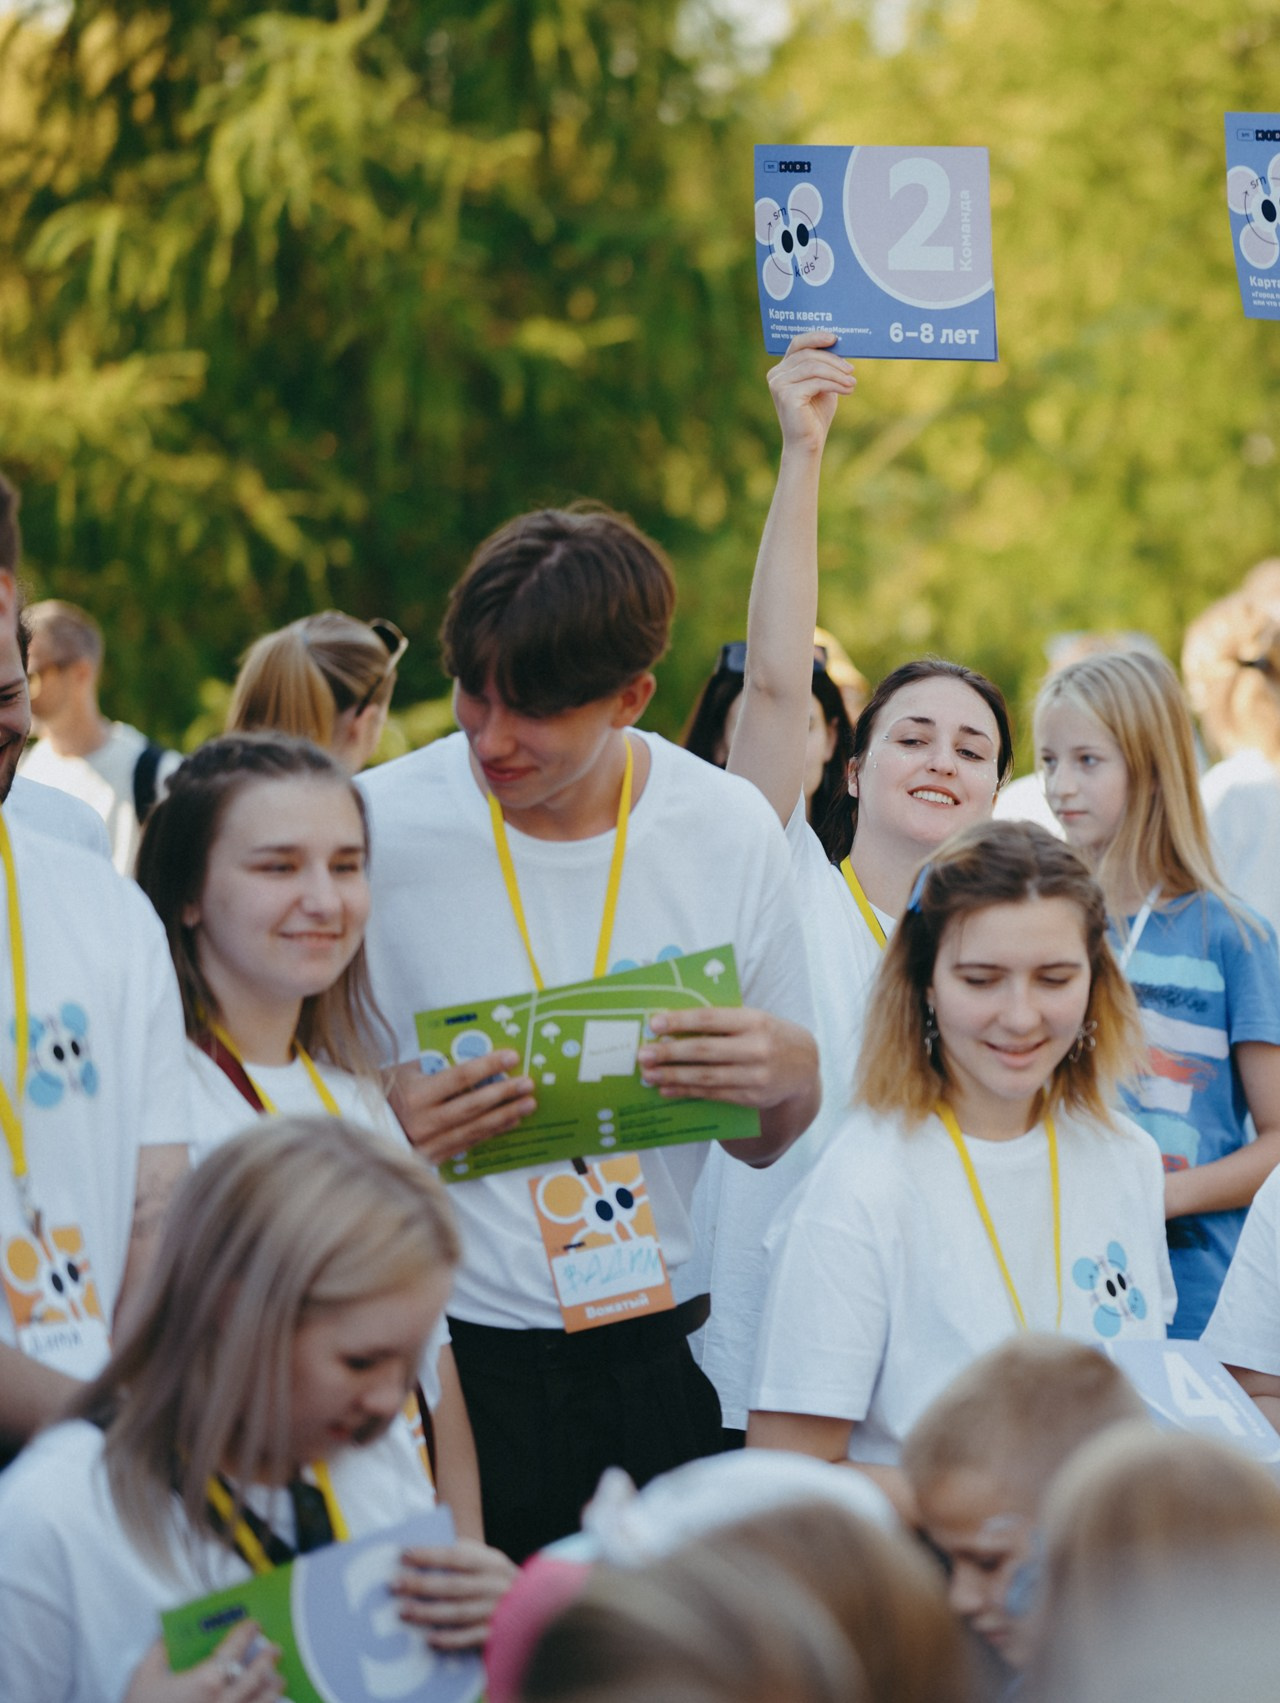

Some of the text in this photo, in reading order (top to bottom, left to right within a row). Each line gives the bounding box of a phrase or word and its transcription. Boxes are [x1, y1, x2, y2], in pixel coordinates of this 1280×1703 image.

[780, 162, 810, 171] KIDS
[1250, 175, 1267, 190] sm
[772, 206, 787, 221] sm
[887, 157, 954, 271] 2
[960, 190, 973, 271] Команда
[794, 261, 816, 278] kids
[768, 308, 833, 322] Карта квеста
[940, 327, 980, 344] лет
[1163, 1350, 1249, 1437] 4
